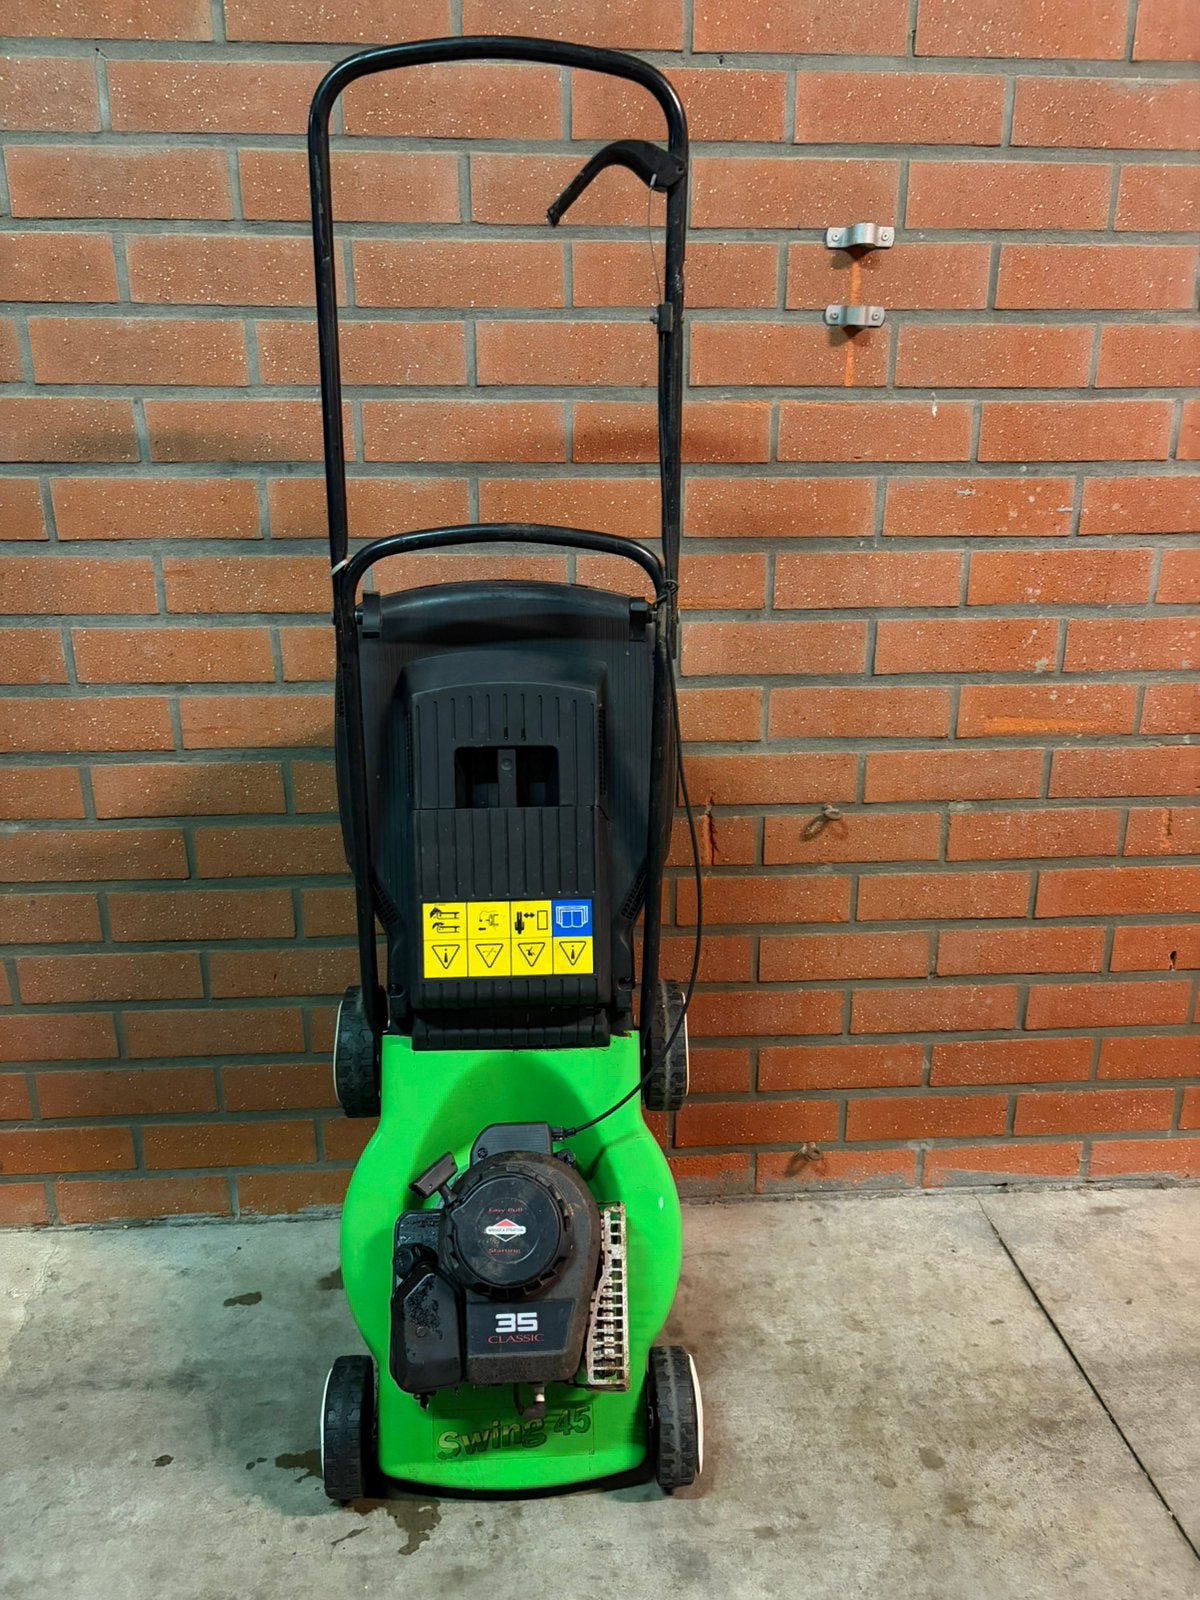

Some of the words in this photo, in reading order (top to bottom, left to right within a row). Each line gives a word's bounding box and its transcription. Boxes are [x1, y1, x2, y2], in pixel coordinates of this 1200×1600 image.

[495, 1312, 538, 1333] 35
[488, 1334, 544, 1344] CLASSIC
[437, 1418, 547, 1460] Swing
[553, 1406, 592, 1436] 45
